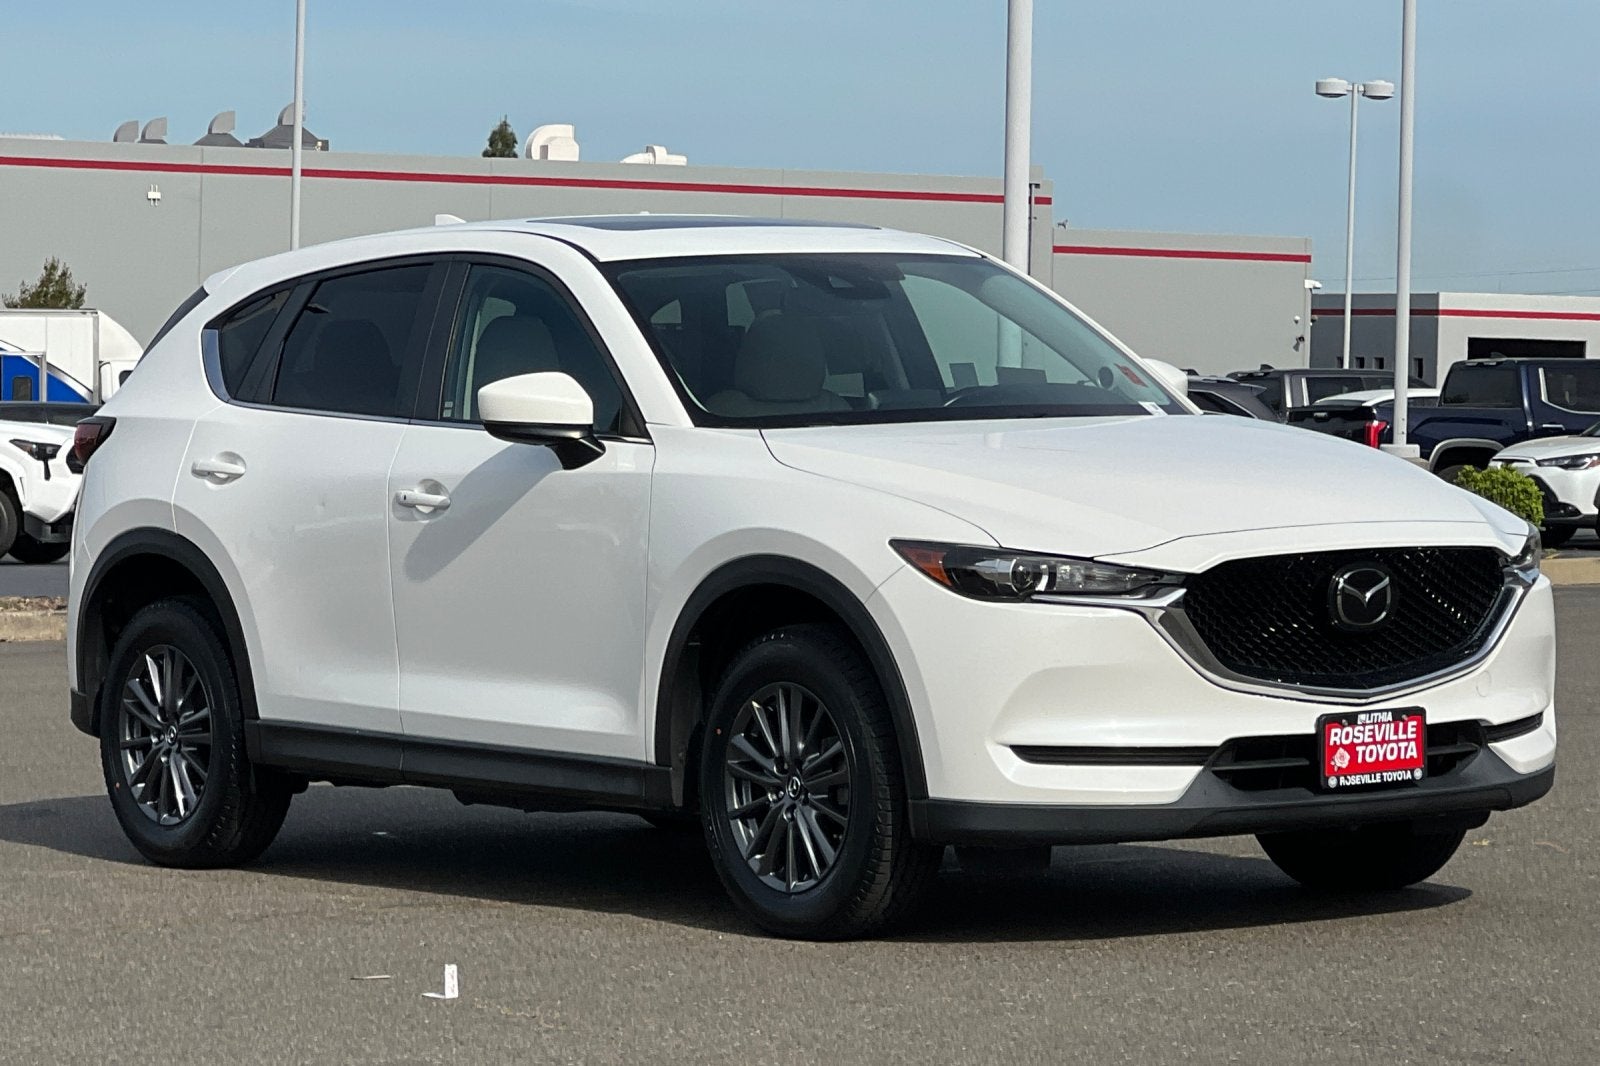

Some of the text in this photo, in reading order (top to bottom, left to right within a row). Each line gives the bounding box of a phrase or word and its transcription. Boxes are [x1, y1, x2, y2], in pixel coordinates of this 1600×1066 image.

[1366, 712, 1393, 723] LITHIA
[1329, 721, 1417, 746] ROSEVILLE
[1356, 741, 1418, 764] TOYOTA
[1382, 770, 1412, 782] TOYOTA
